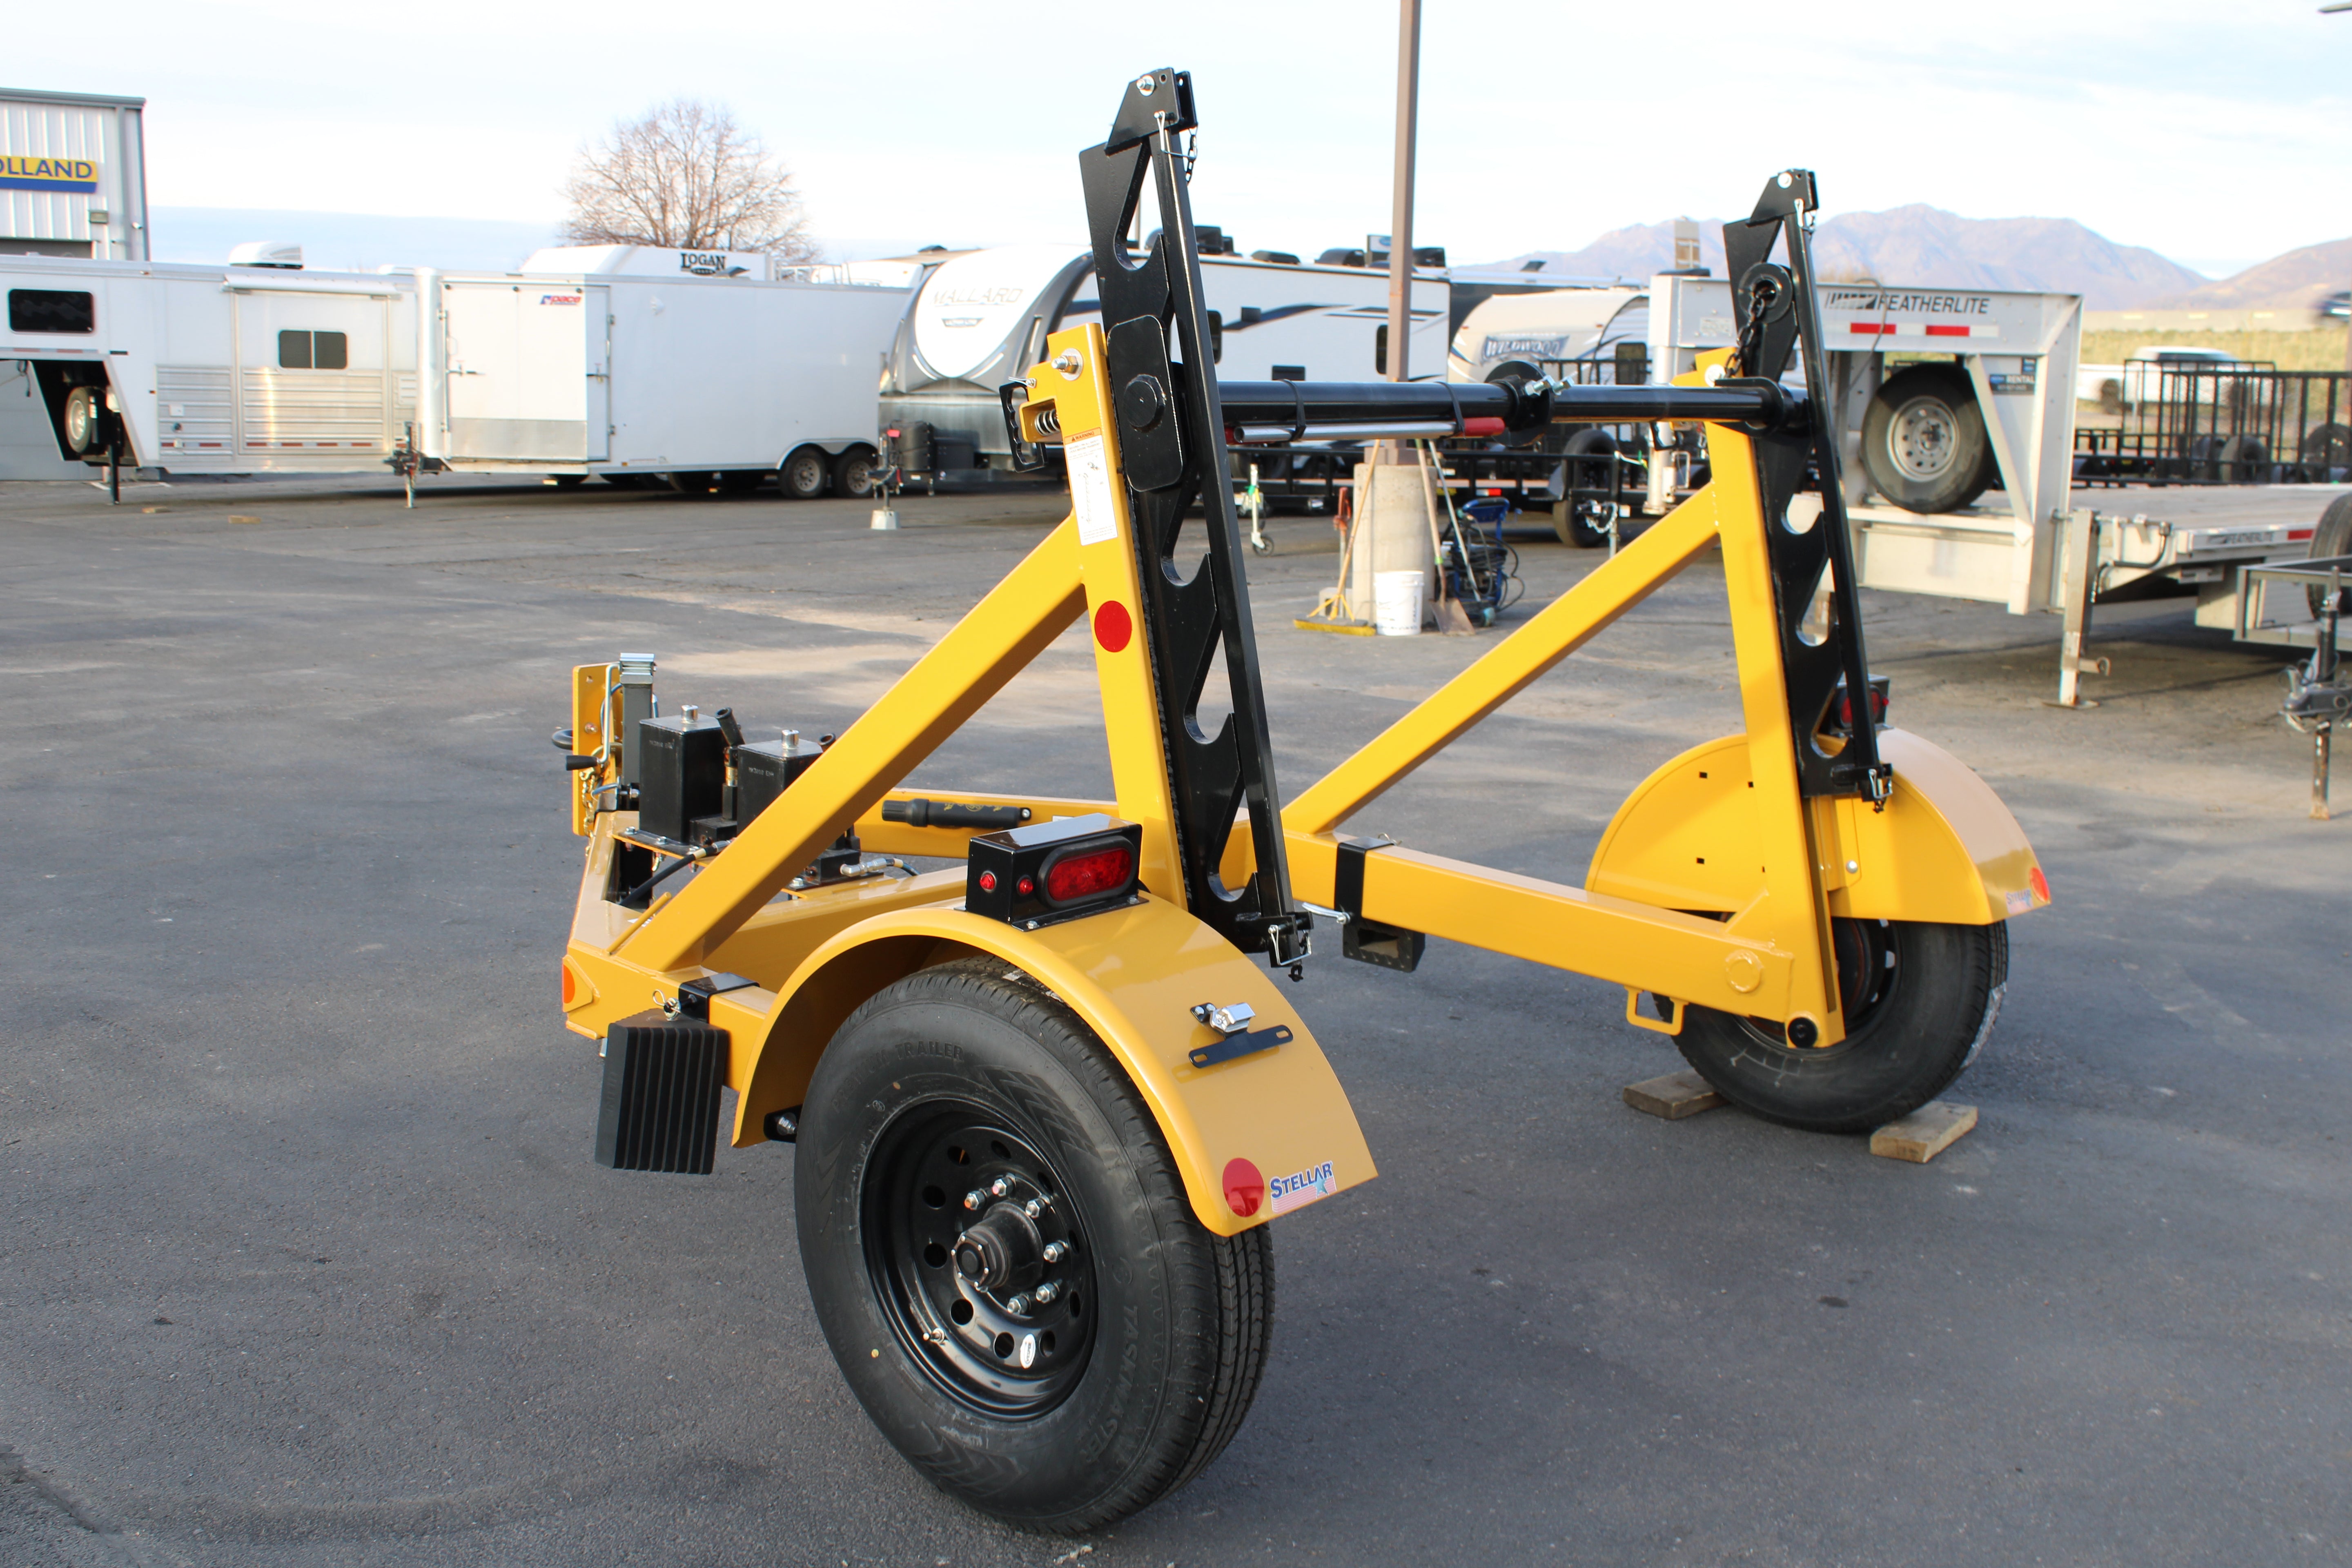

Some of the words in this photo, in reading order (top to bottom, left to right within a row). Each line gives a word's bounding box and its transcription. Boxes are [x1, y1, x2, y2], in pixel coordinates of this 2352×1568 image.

[0, 158, 93, 178] LLAND
[681, 252, 726, 270] LOGAN
[930, 287, 1023, 304] MALLARD
[1877, 294, 1991, 314] FEATHERLITE
[2006, 375, 2035, 383] RENTAL
[1075, 431, 1095, 440] WARNING
[895, 1040, 965, 1063] TRAILER
[1270, 1163, 1332, 1198] STELLAR
[1079, 1305, 1139, 1463] TASKMASTER
